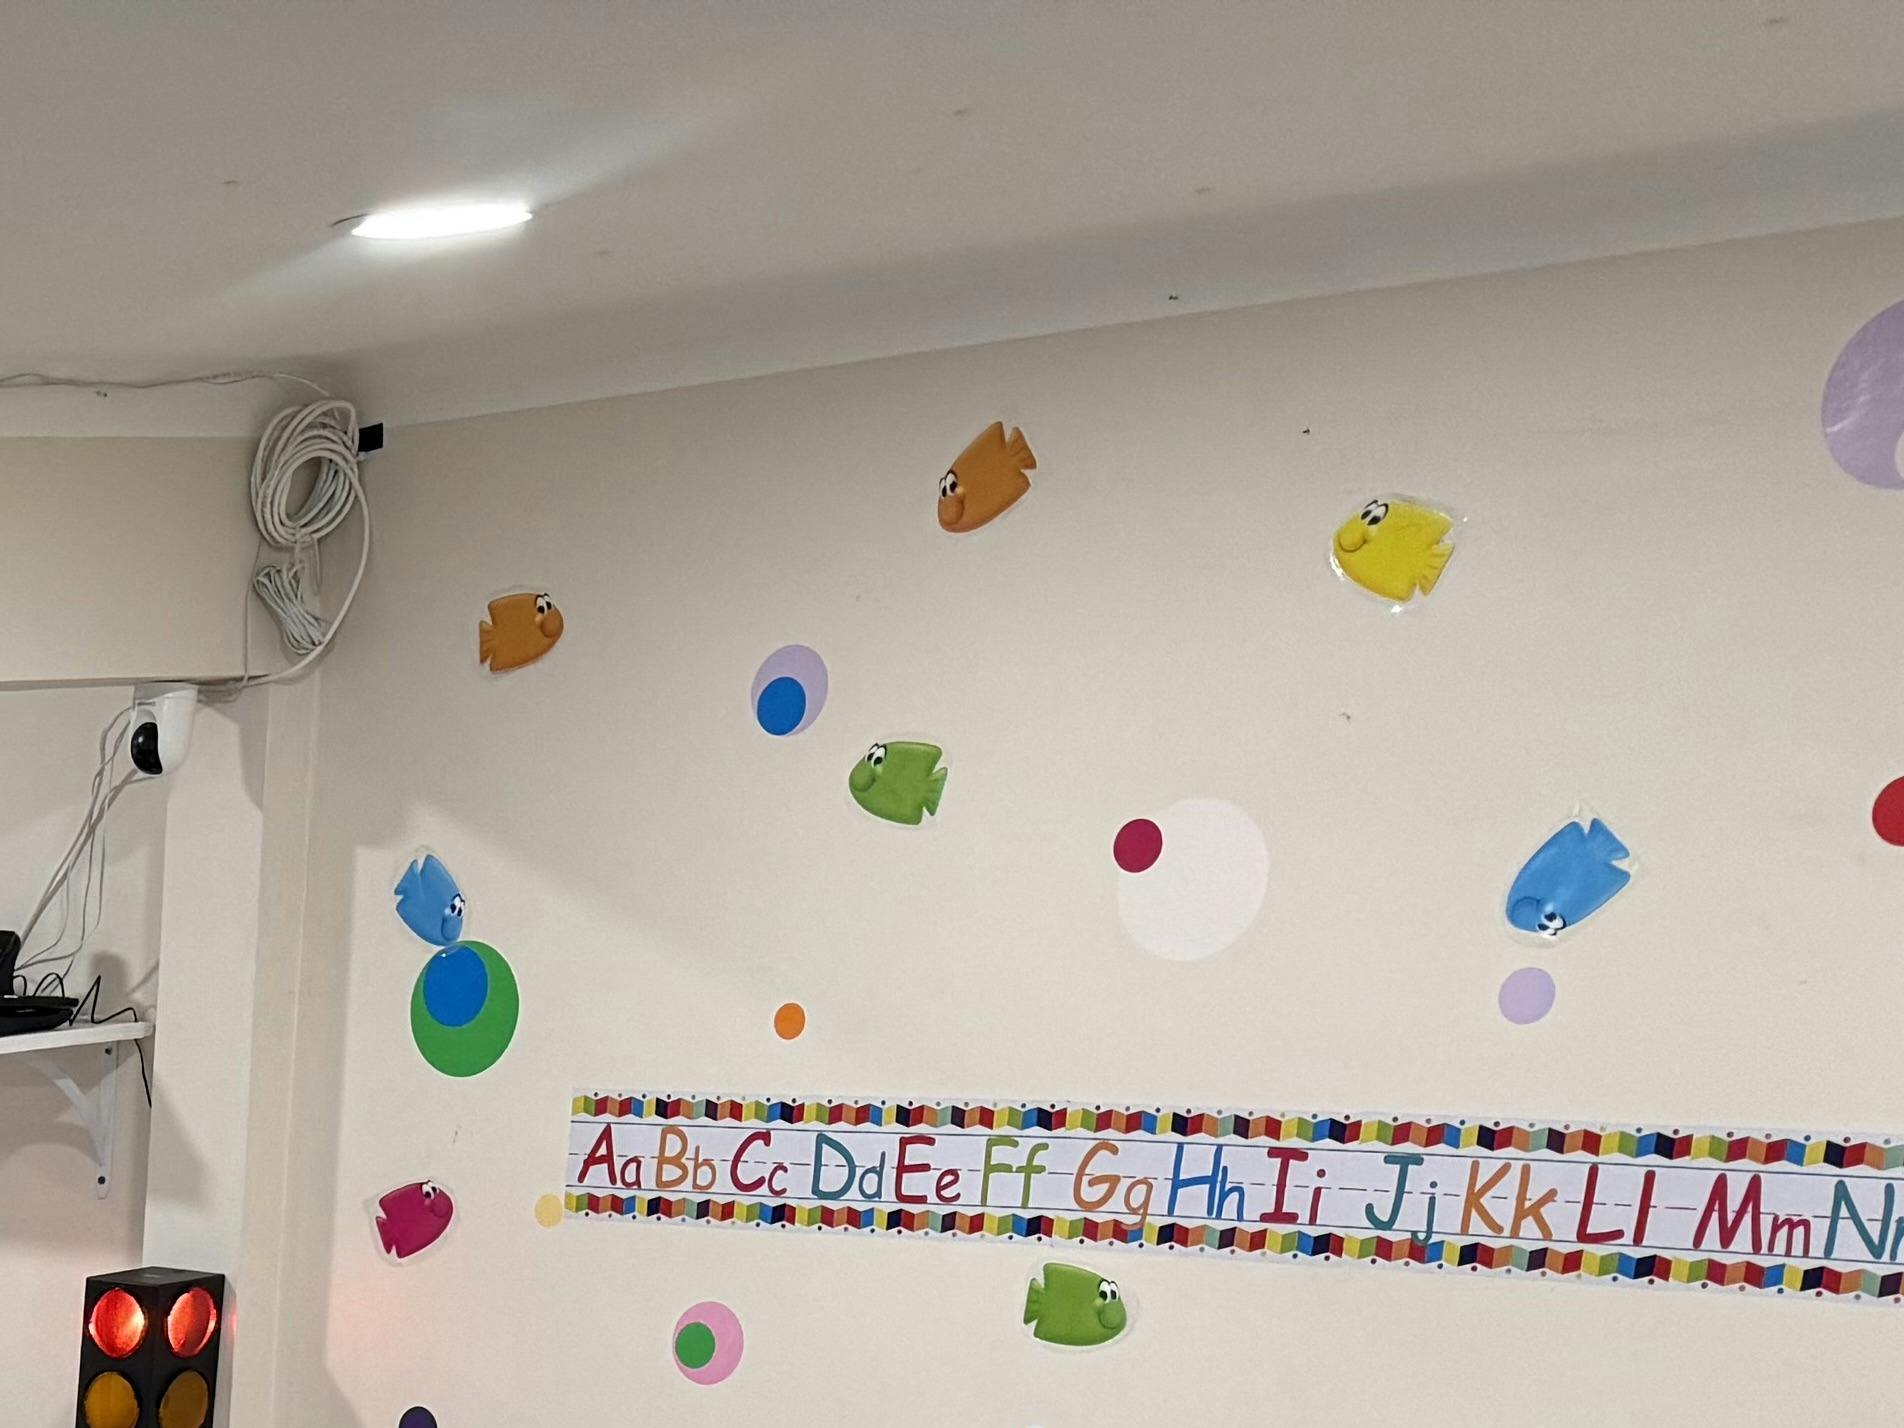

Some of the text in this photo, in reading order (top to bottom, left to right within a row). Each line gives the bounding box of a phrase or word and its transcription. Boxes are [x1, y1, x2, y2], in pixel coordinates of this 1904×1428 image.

[577, 1123, 1811, 1257] Aa Bb Cc Dd Ee Ff Gg Hh Ii Jj Kk Ll Mm
